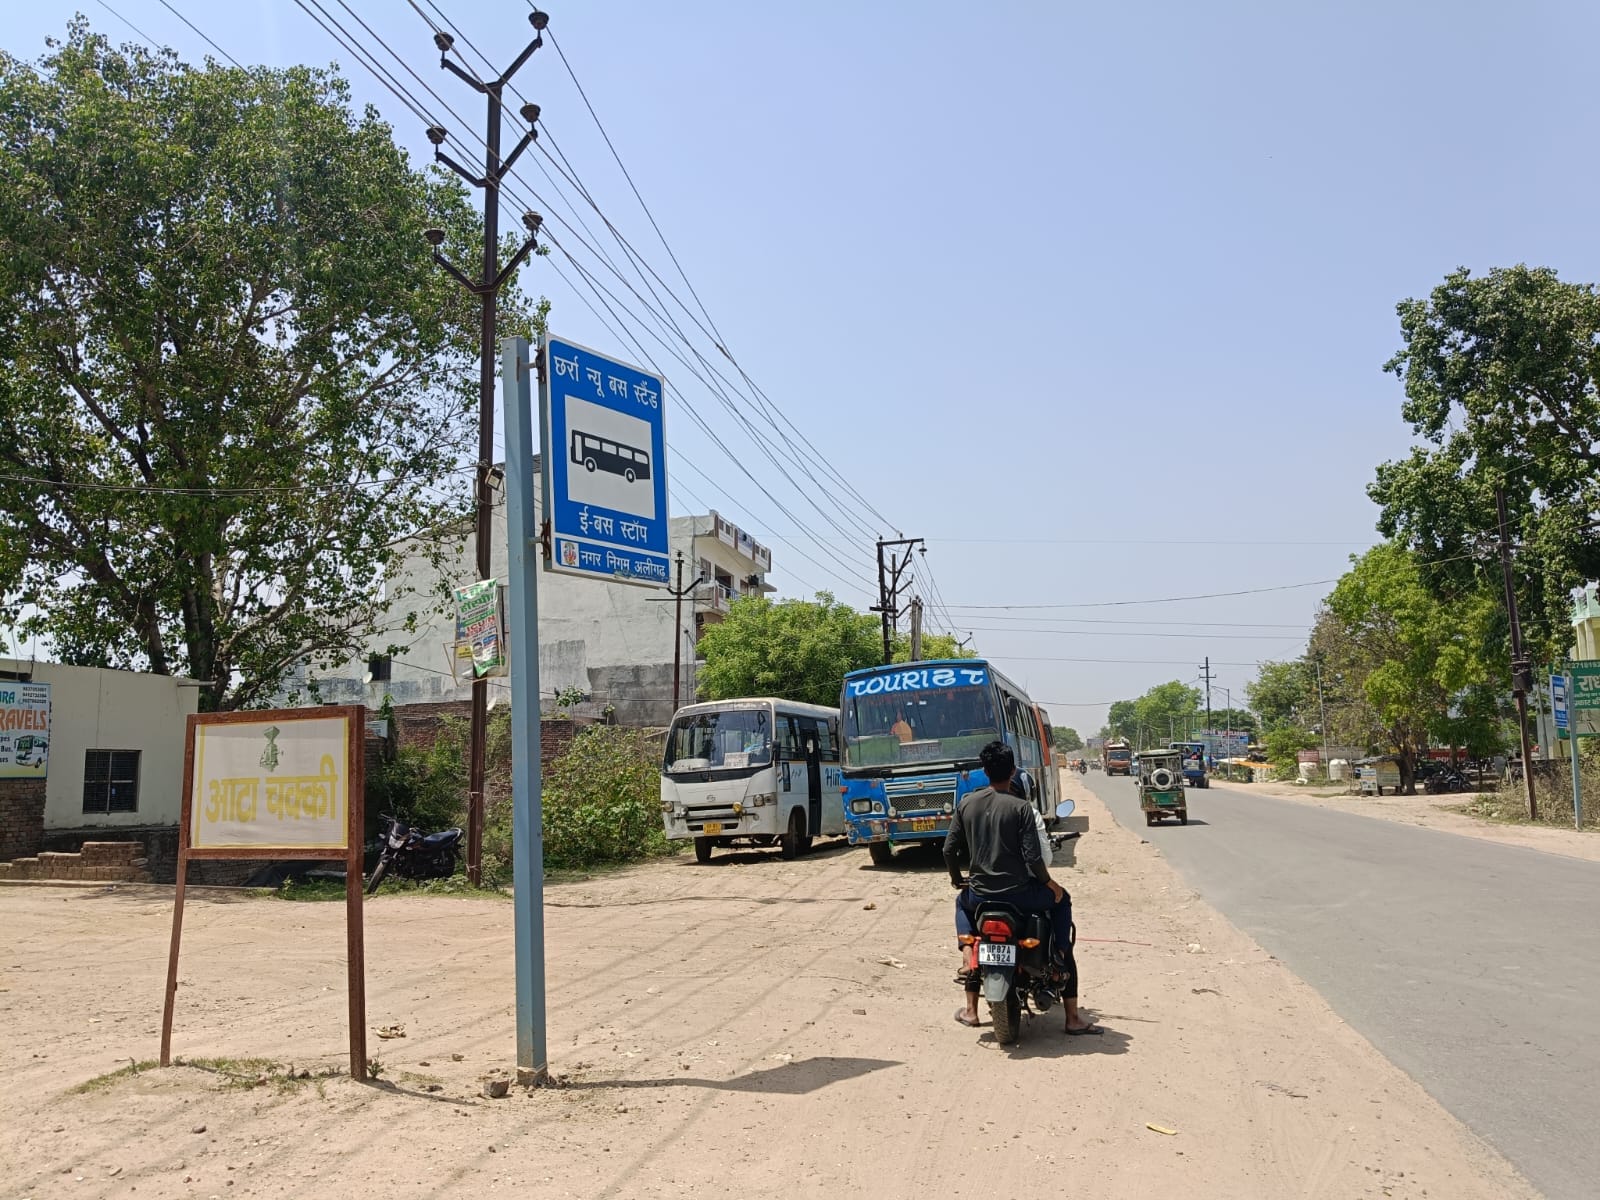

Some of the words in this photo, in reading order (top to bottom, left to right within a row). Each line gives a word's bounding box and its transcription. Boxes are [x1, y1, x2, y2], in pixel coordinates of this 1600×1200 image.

[553, 354, 580, 382] छर्रा
[586, 367, 605, 398] न्यू
[608, 375, 628, 399] बस
[632, 380, 658, 409] स्टैंड
[578, 505, 614, 536] ई-बस
[619, 519, 648, 544] स्टॉप
[579, 550, 602, 566] नगर
[606, 550, 630, 570] निगम
[850, 668, 984, 696] TOURIST
[205, 777, 260, 823] आटा
[265, 753, 338, 821] चक्की
